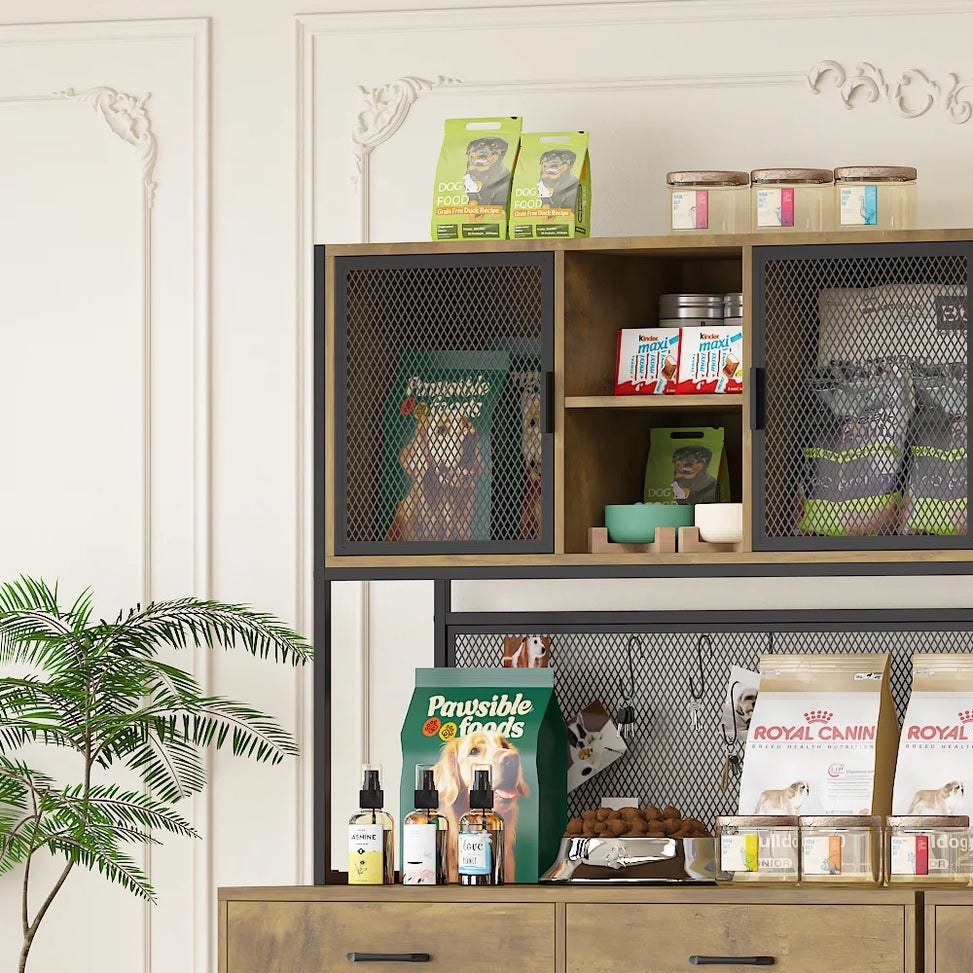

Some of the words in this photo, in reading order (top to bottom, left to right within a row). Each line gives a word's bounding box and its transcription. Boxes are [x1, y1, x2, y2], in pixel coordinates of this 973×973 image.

[438, 181, 463, 192] DOG
[515, 188, 536, 197] DOG
[437, 195, 470, 206] FOOD
[514, 199, 543, 209] FOOD
[480, 206, 500, 216] Recipe
[700, 332, 720, 340] kinder
[638, 337, 668, 354] maxi
[699, 335, 729, 352] maxi
[648, 488, 671, 498] DOG
[427, 693, 532, 718] Pawsible
[459, 716, 526, 739] foods
[754, 726, 814, 740] ROYAL
[818, 726, 876, 740] CANIN
[907, 725, 968, 740] ROYAL
